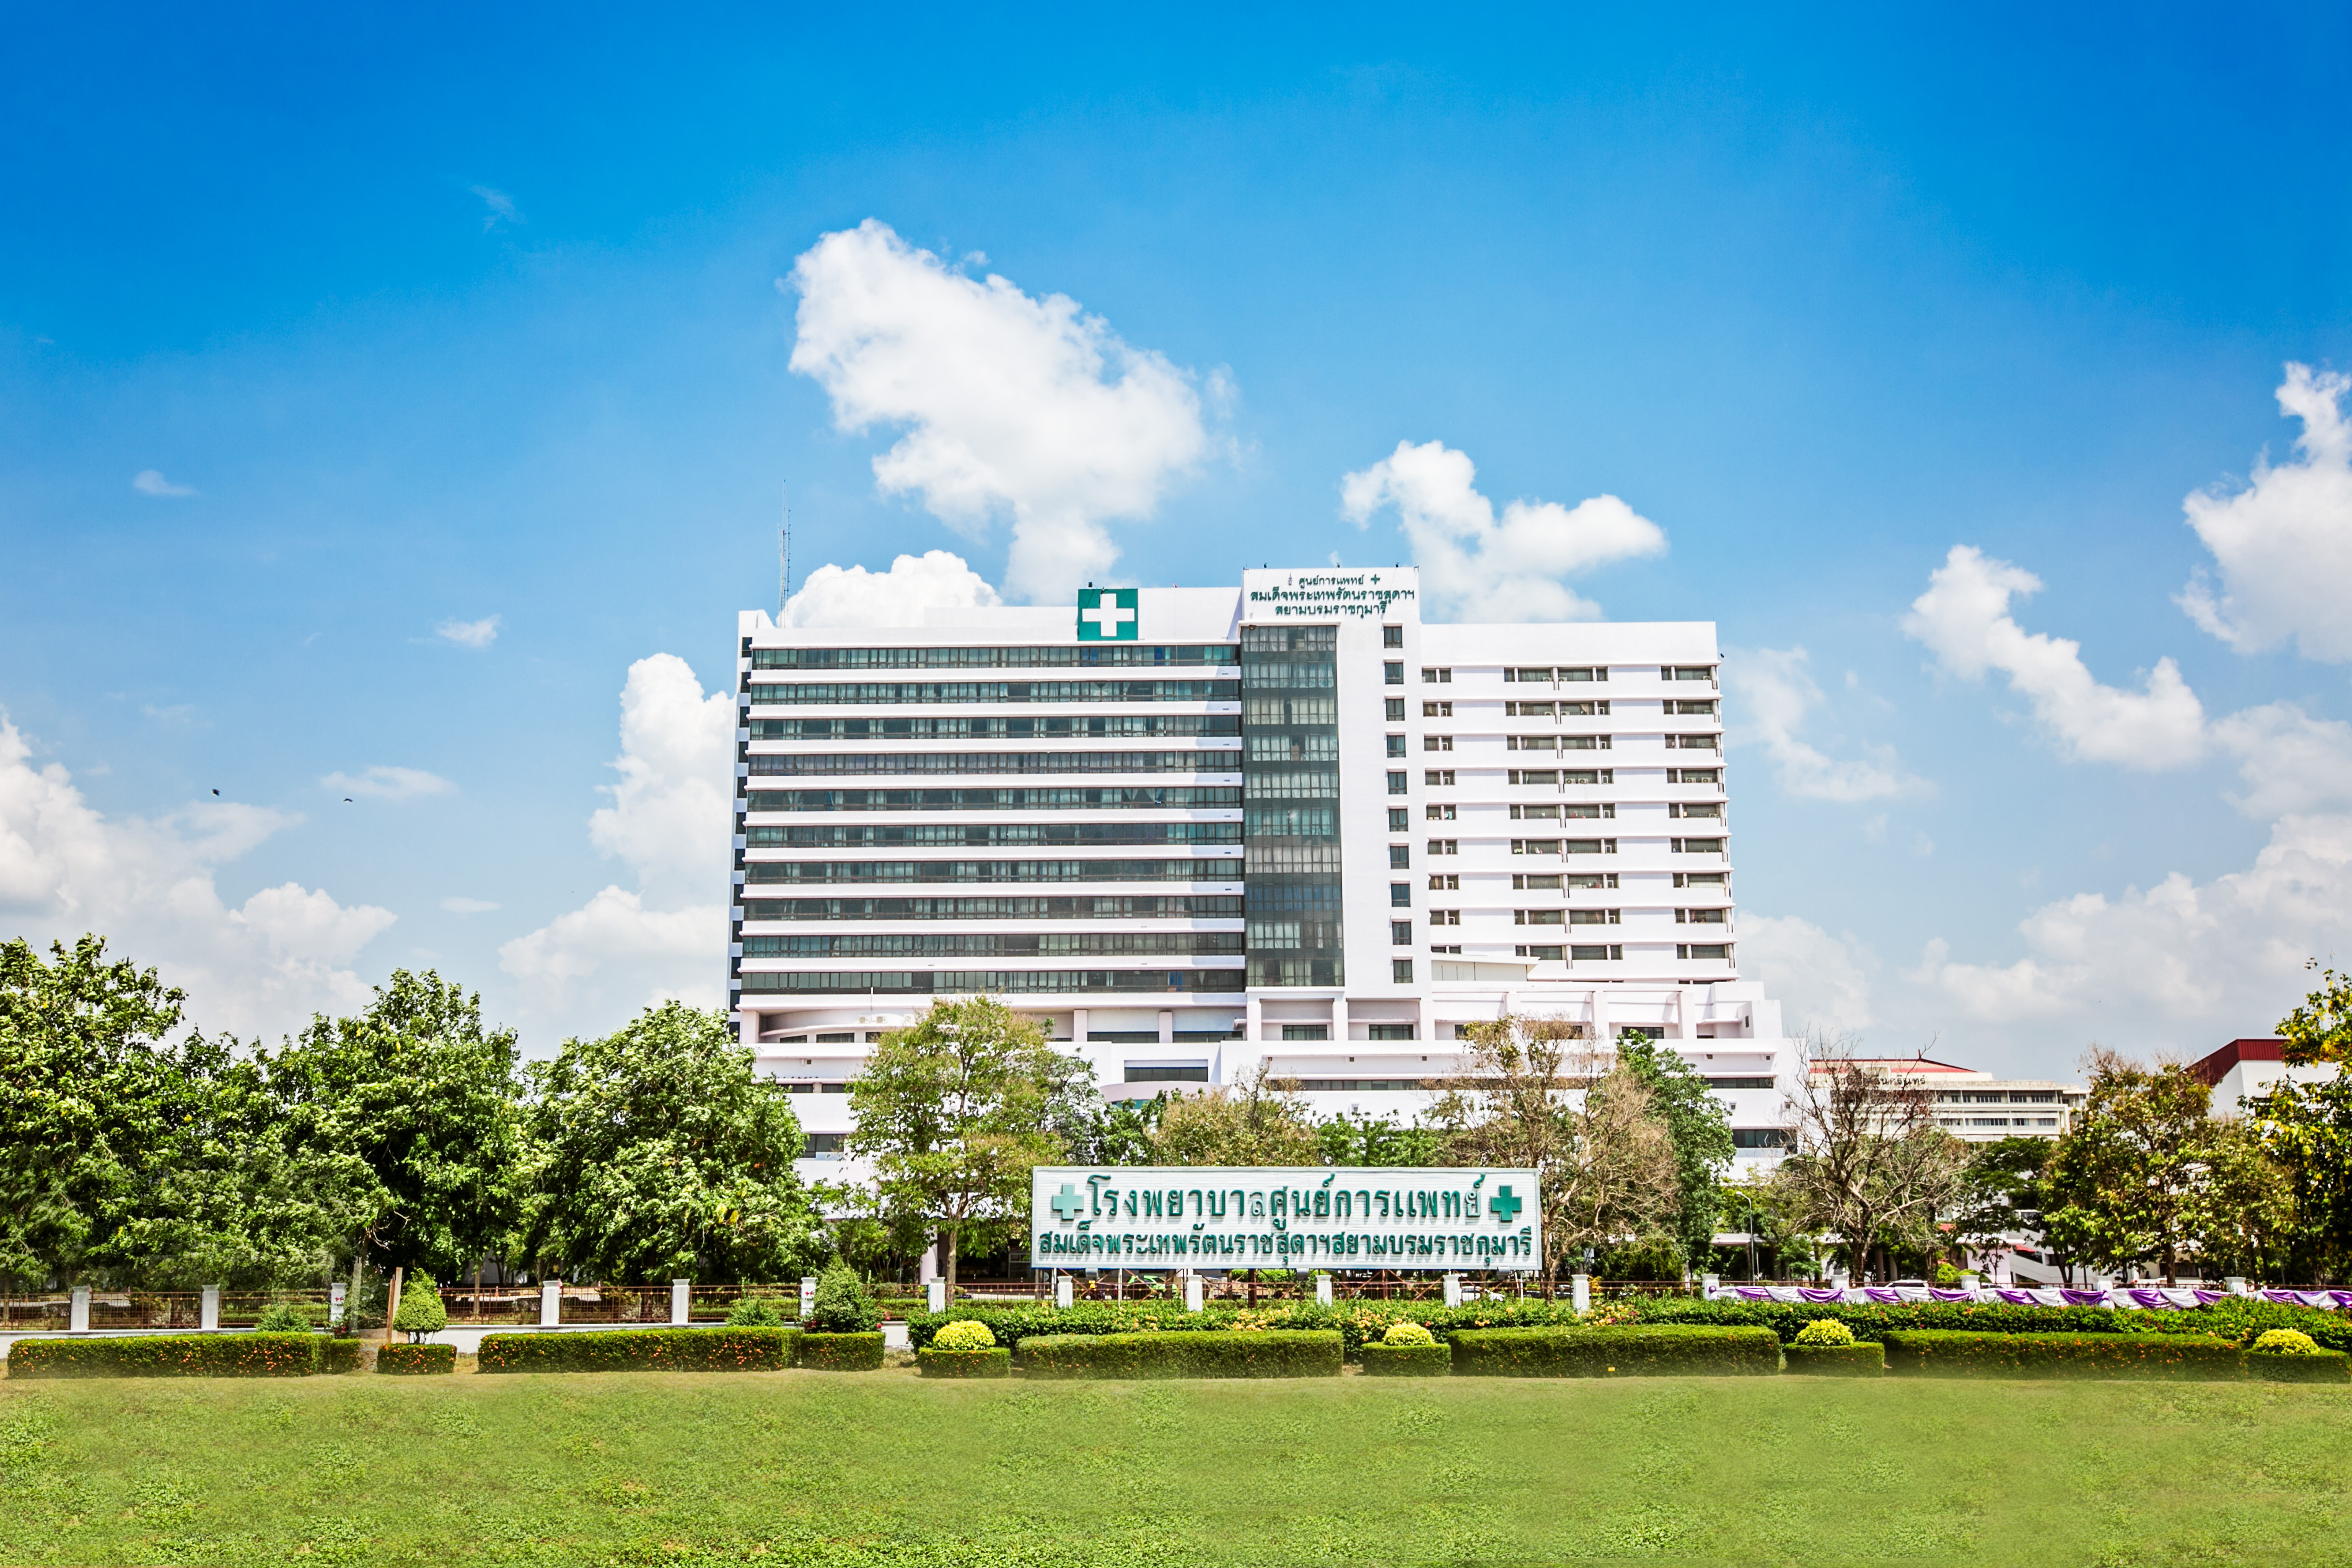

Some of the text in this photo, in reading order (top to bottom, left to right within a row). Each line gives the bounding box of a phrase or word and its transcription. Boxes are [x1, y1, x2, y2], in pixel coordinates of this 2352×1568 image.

[1299, 575, 1364, 589] ศูนย์การแพทย์
[1275, 600, 1387, 618] สยามบรมราชกุมารี
[1087, 1173, 1486, 1230] โรงพยาบาลศูนย์การแพทย์
